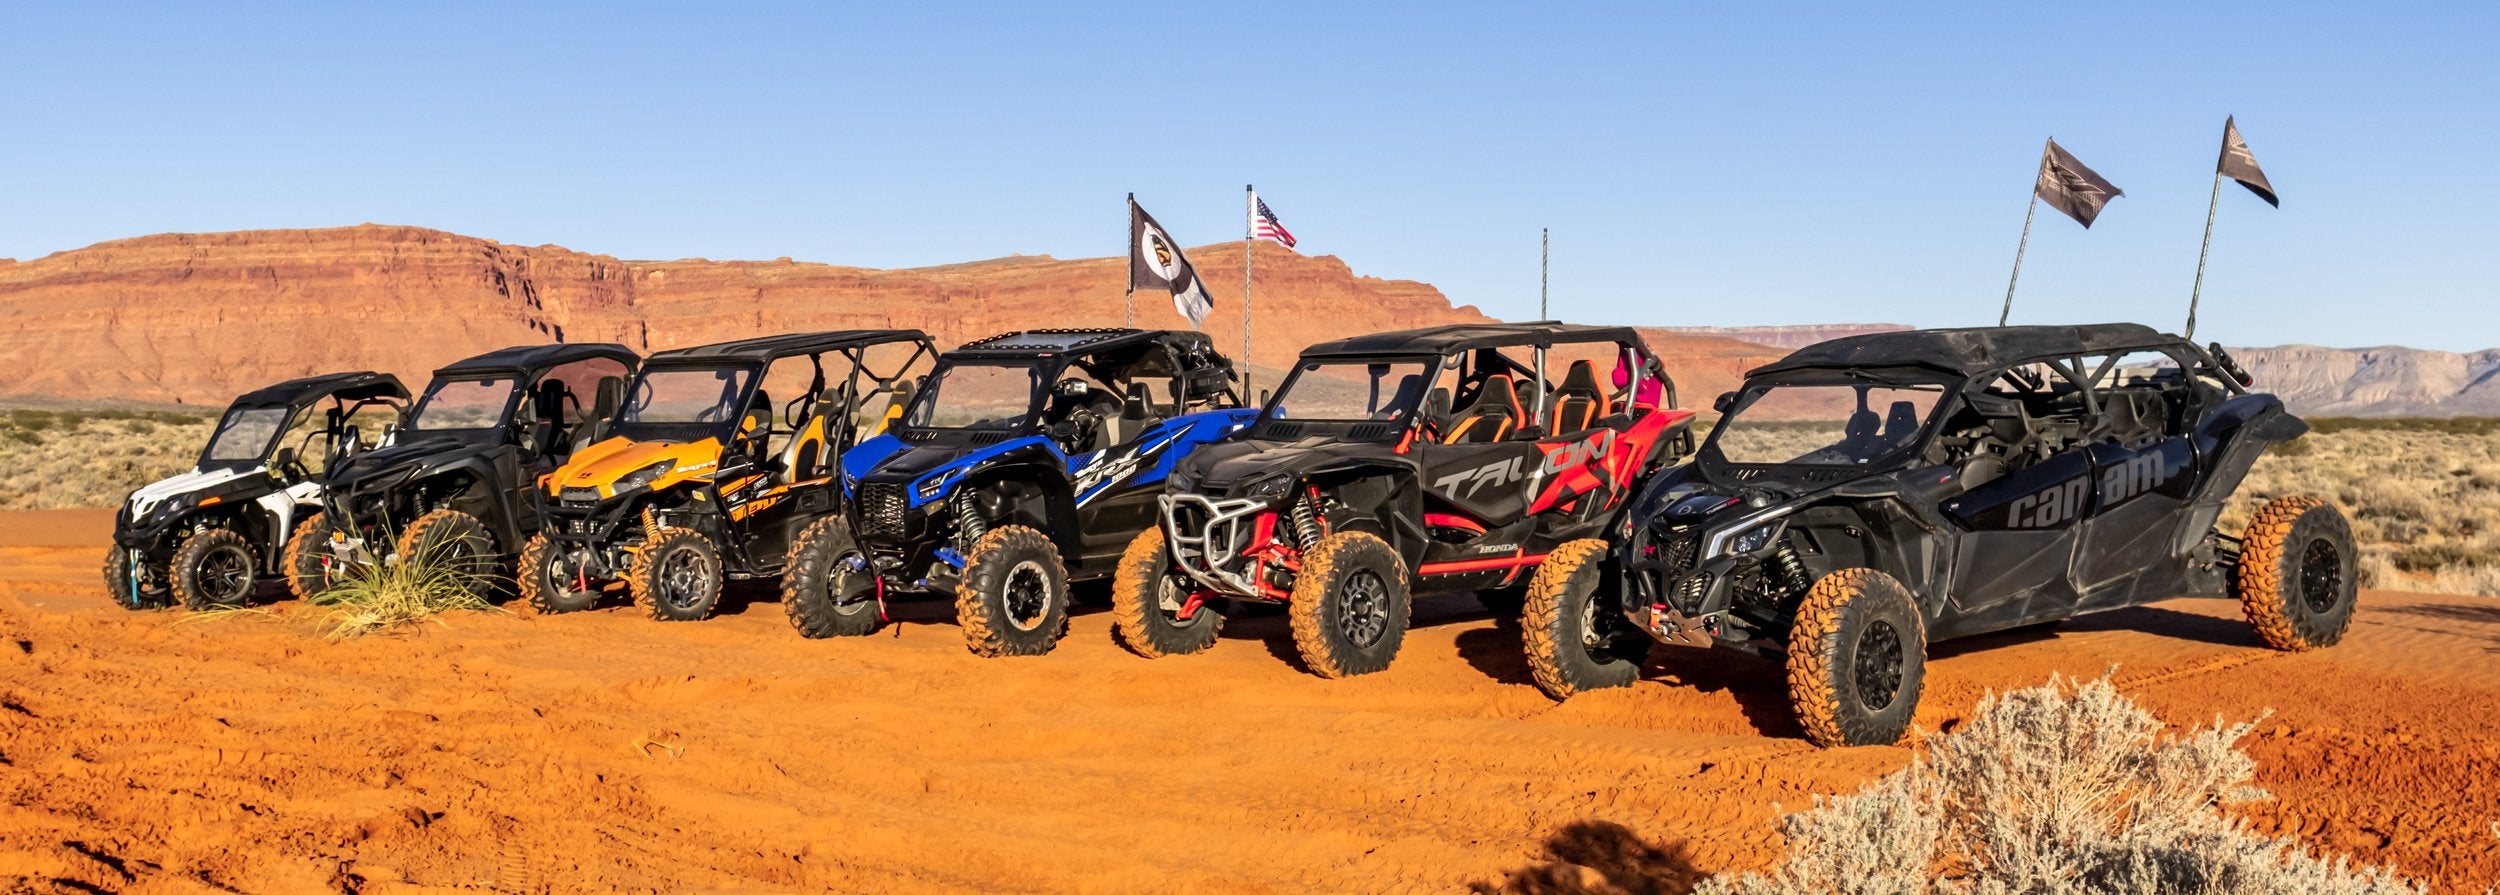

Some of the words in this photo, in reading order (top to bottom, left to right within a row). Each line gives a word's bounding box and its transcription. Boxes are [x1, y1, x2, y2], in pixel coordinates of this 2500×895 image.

[1112, 463, 1137, 482] 1000
[1434, 432, 1610, 500] TALON
[2104, 450, 2165, 506] am
[1479, 543, 1518, 554] HONDA
